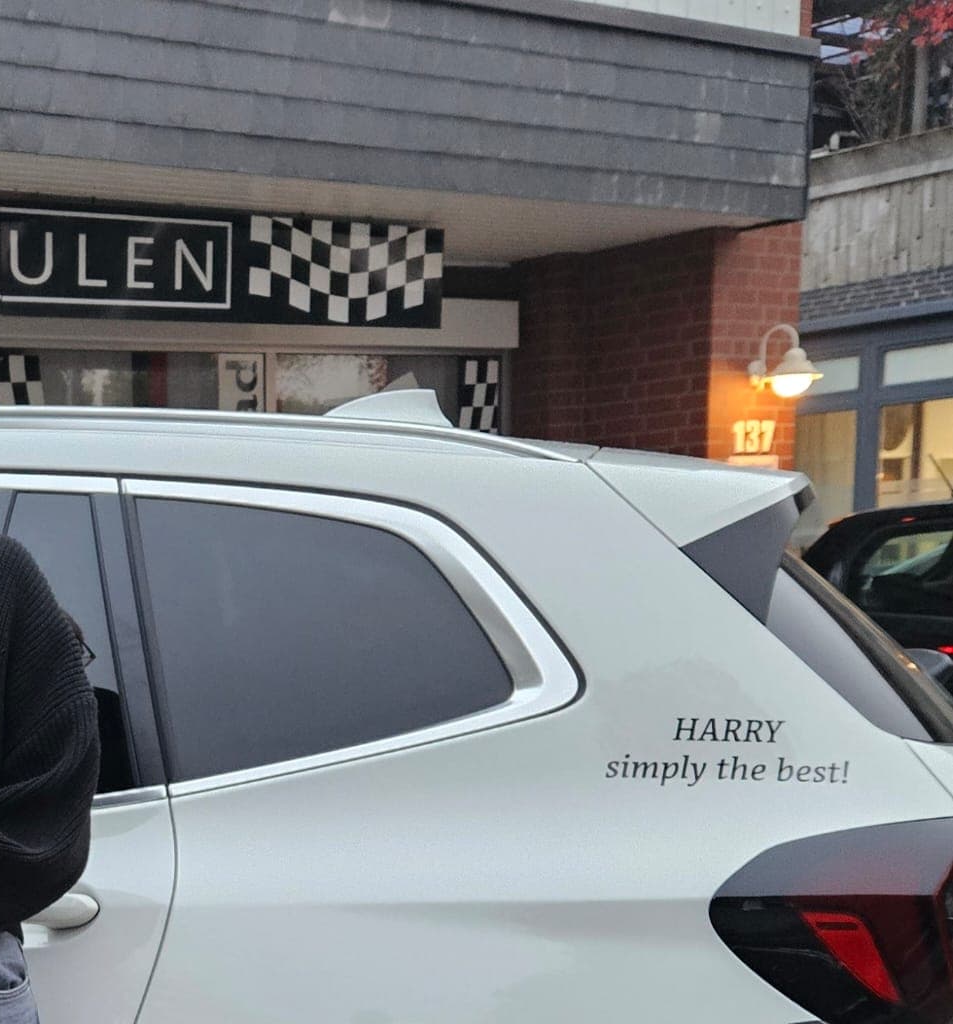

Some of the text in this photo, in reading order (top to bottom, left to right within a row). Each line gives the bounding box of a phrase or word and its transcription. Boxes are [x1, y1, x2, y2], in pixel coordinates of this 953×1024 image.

[732, 419, 776, 453] 137
[672, 717, 786, 743] HARRY
[605, 753, 850, 787] simply the best!
